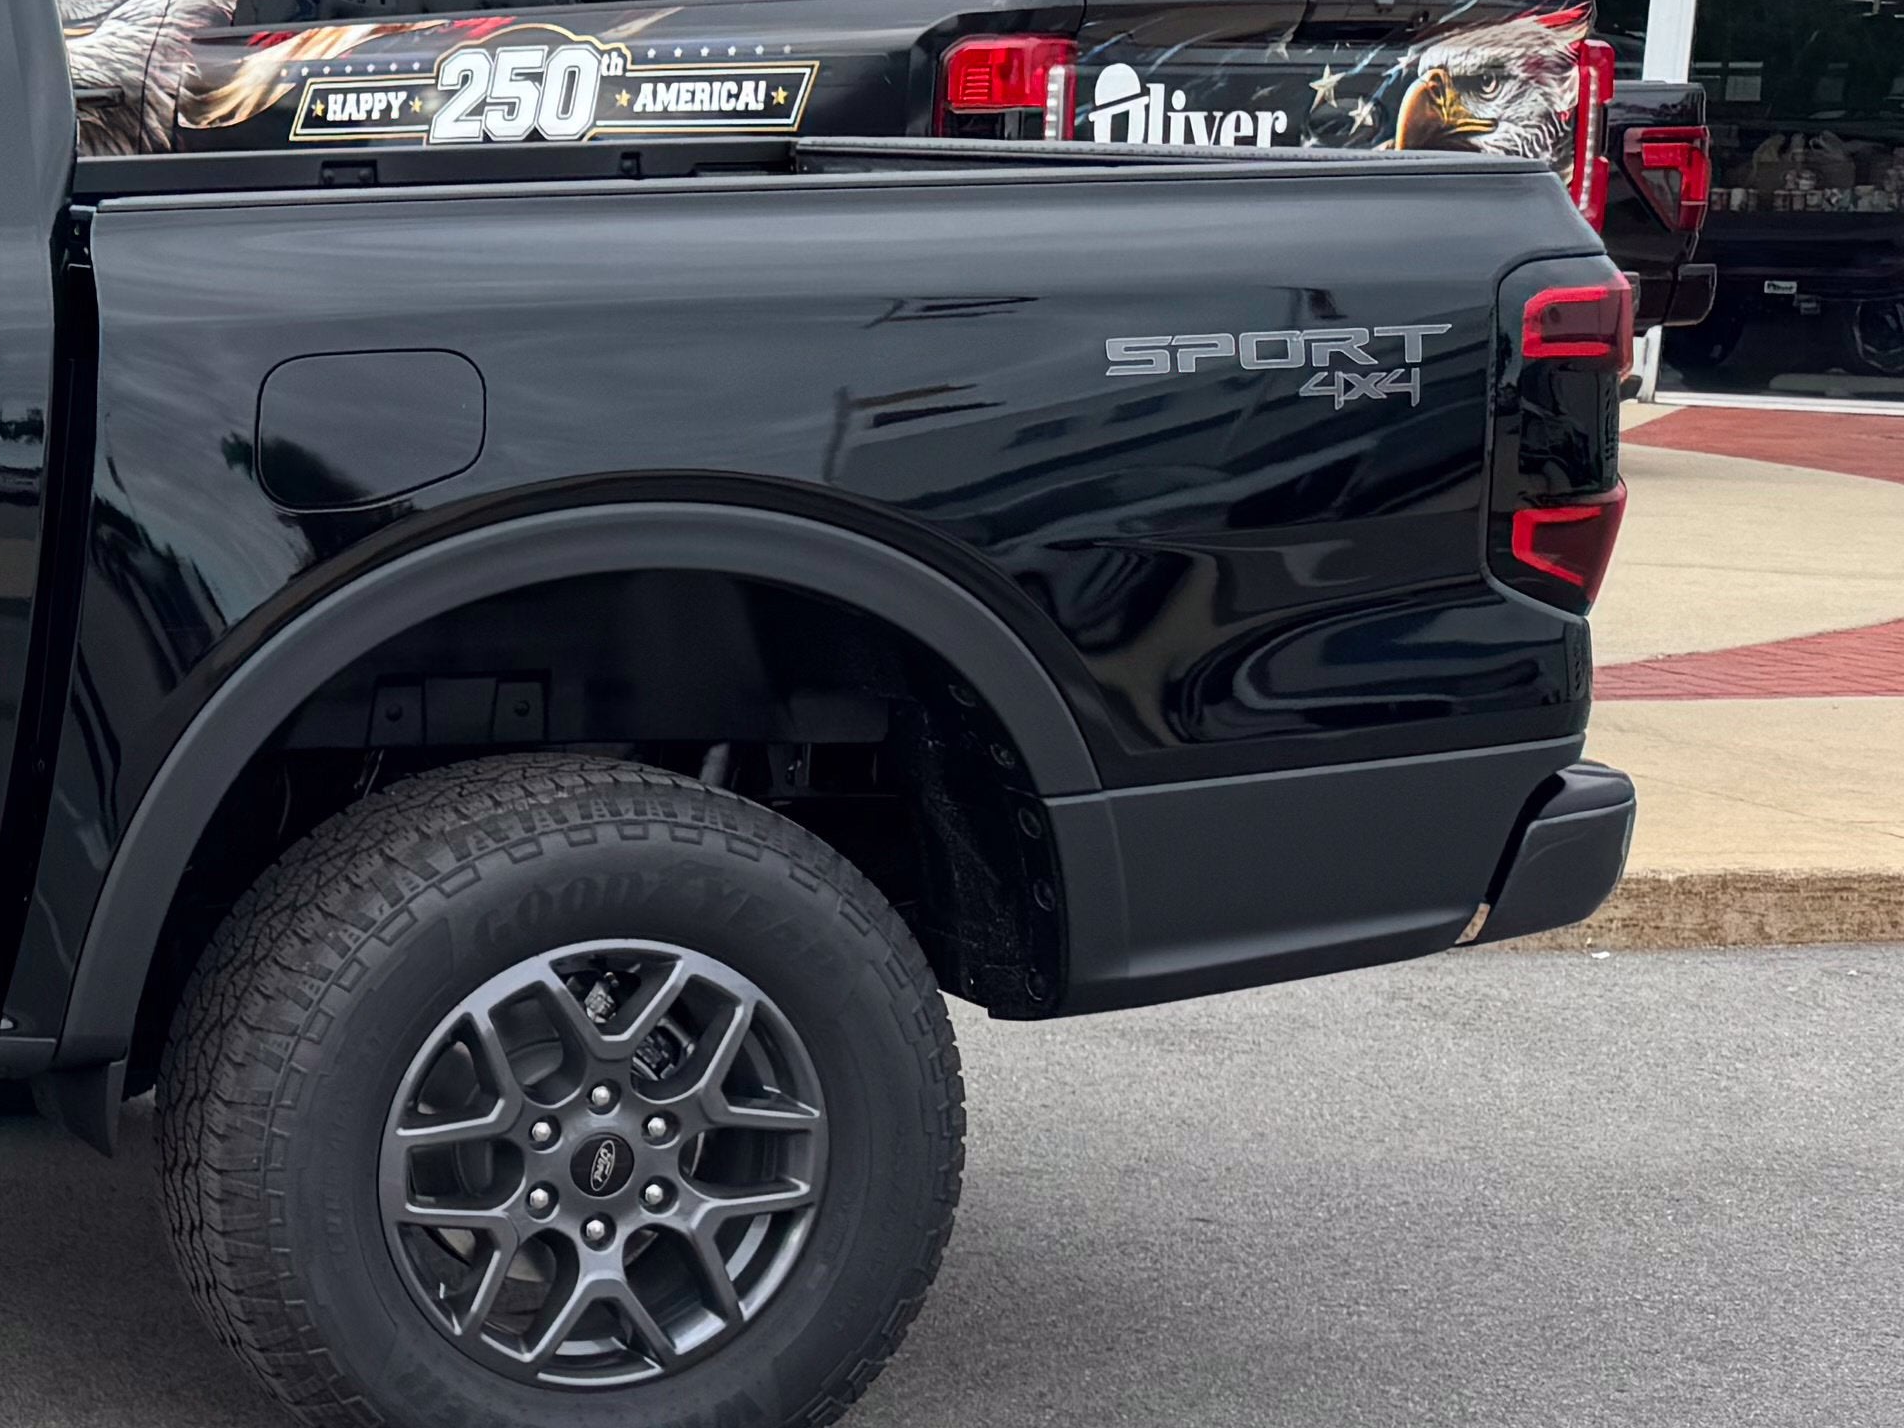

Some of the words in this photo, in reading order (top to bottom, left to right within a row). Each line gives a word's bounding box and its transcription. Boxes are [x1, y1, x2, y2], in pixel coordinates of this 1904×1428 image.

[326, 91, 407, 122] HAPPY
[633, 79, 767, 113] AMERICA!
[1088, 63, 1288, 149] Oliver
[1106, 323, 1452, 376] SPORT
[471, 858, 844, 976] GOODYEAR
